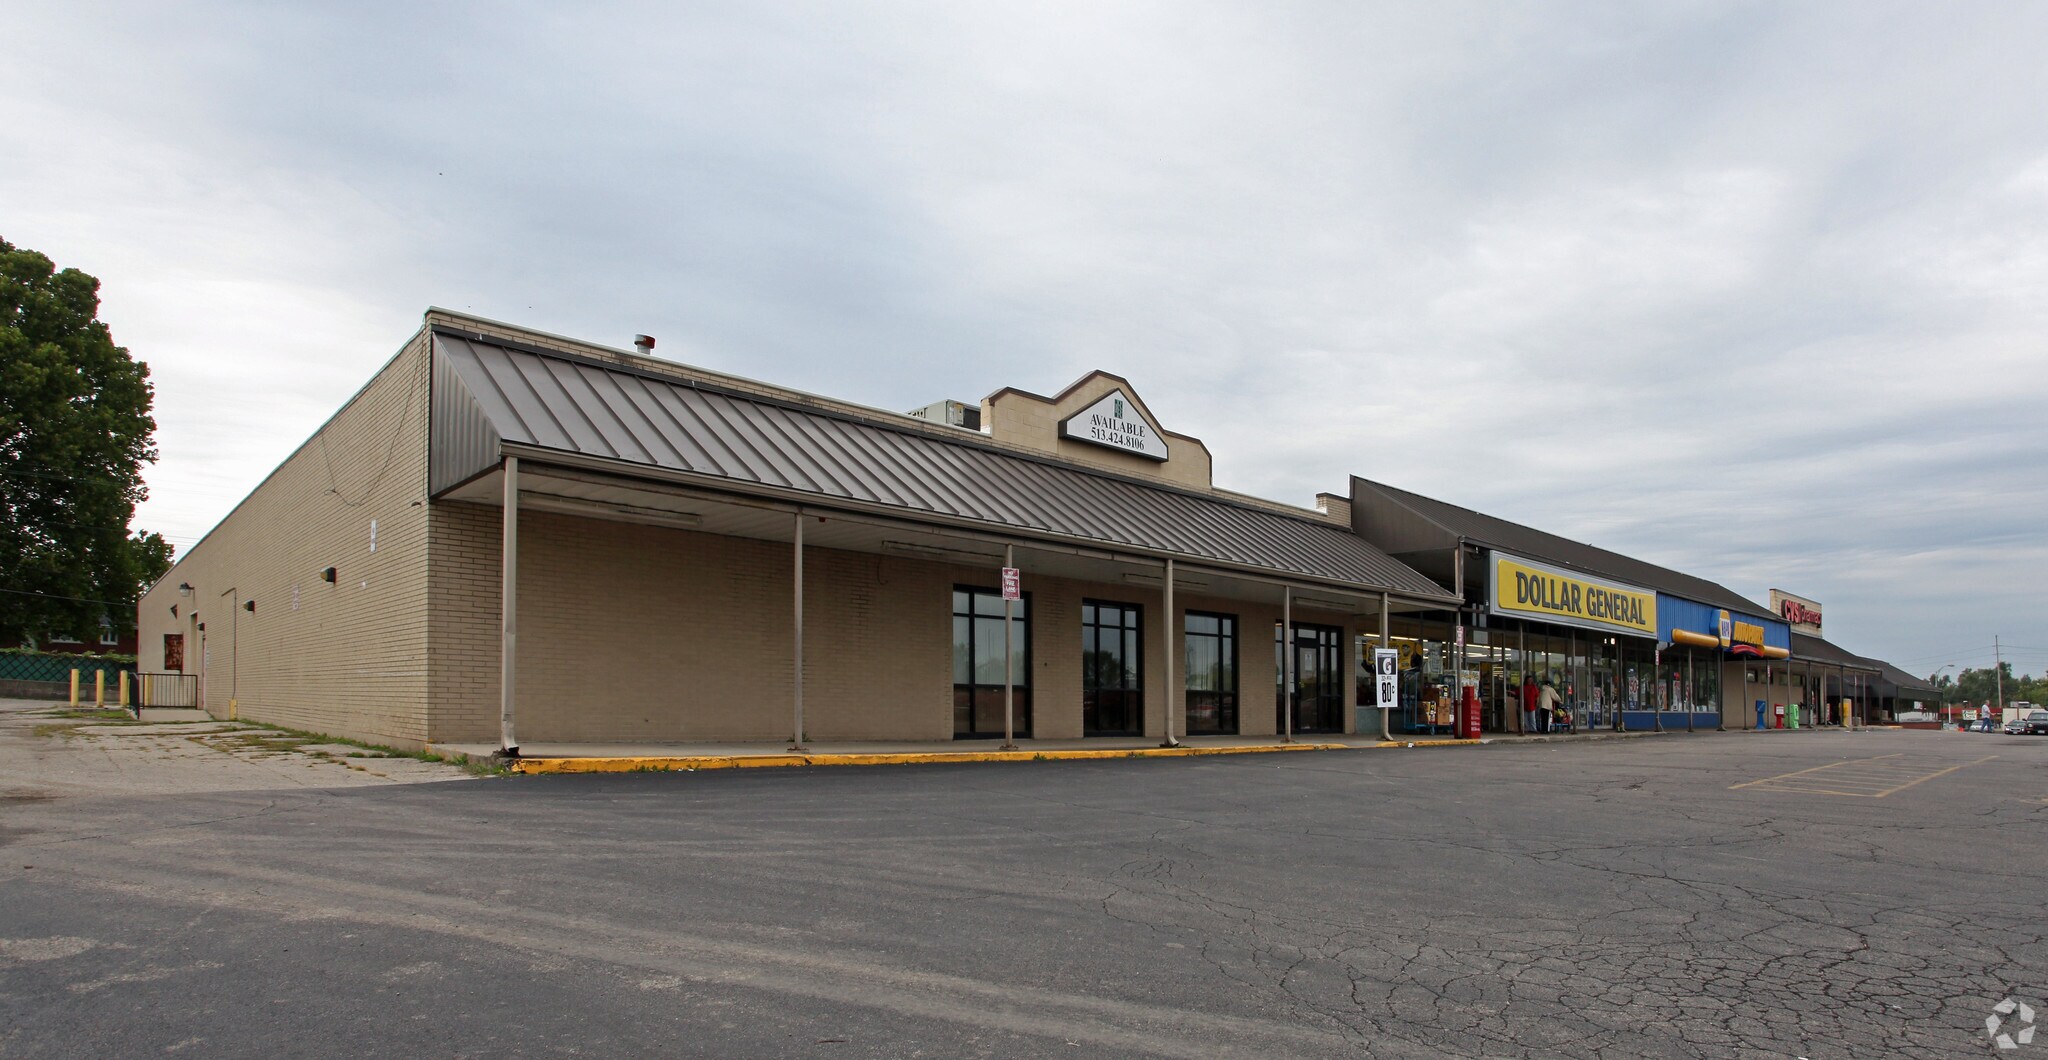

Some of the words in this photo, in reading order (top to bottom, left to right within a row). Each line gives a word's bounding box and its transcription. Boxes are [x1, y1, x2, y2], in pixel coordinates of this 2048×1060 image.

[1090, 414, 1146, 437] AVAILABLE
[1091, 426, 1145, 450] 513.424.8106
[1516, 571, 1582, 614] DOLLAR
[1586, 586, 1646, 625] GENERAL
[1721, 620, 1730, 637] NAPA
